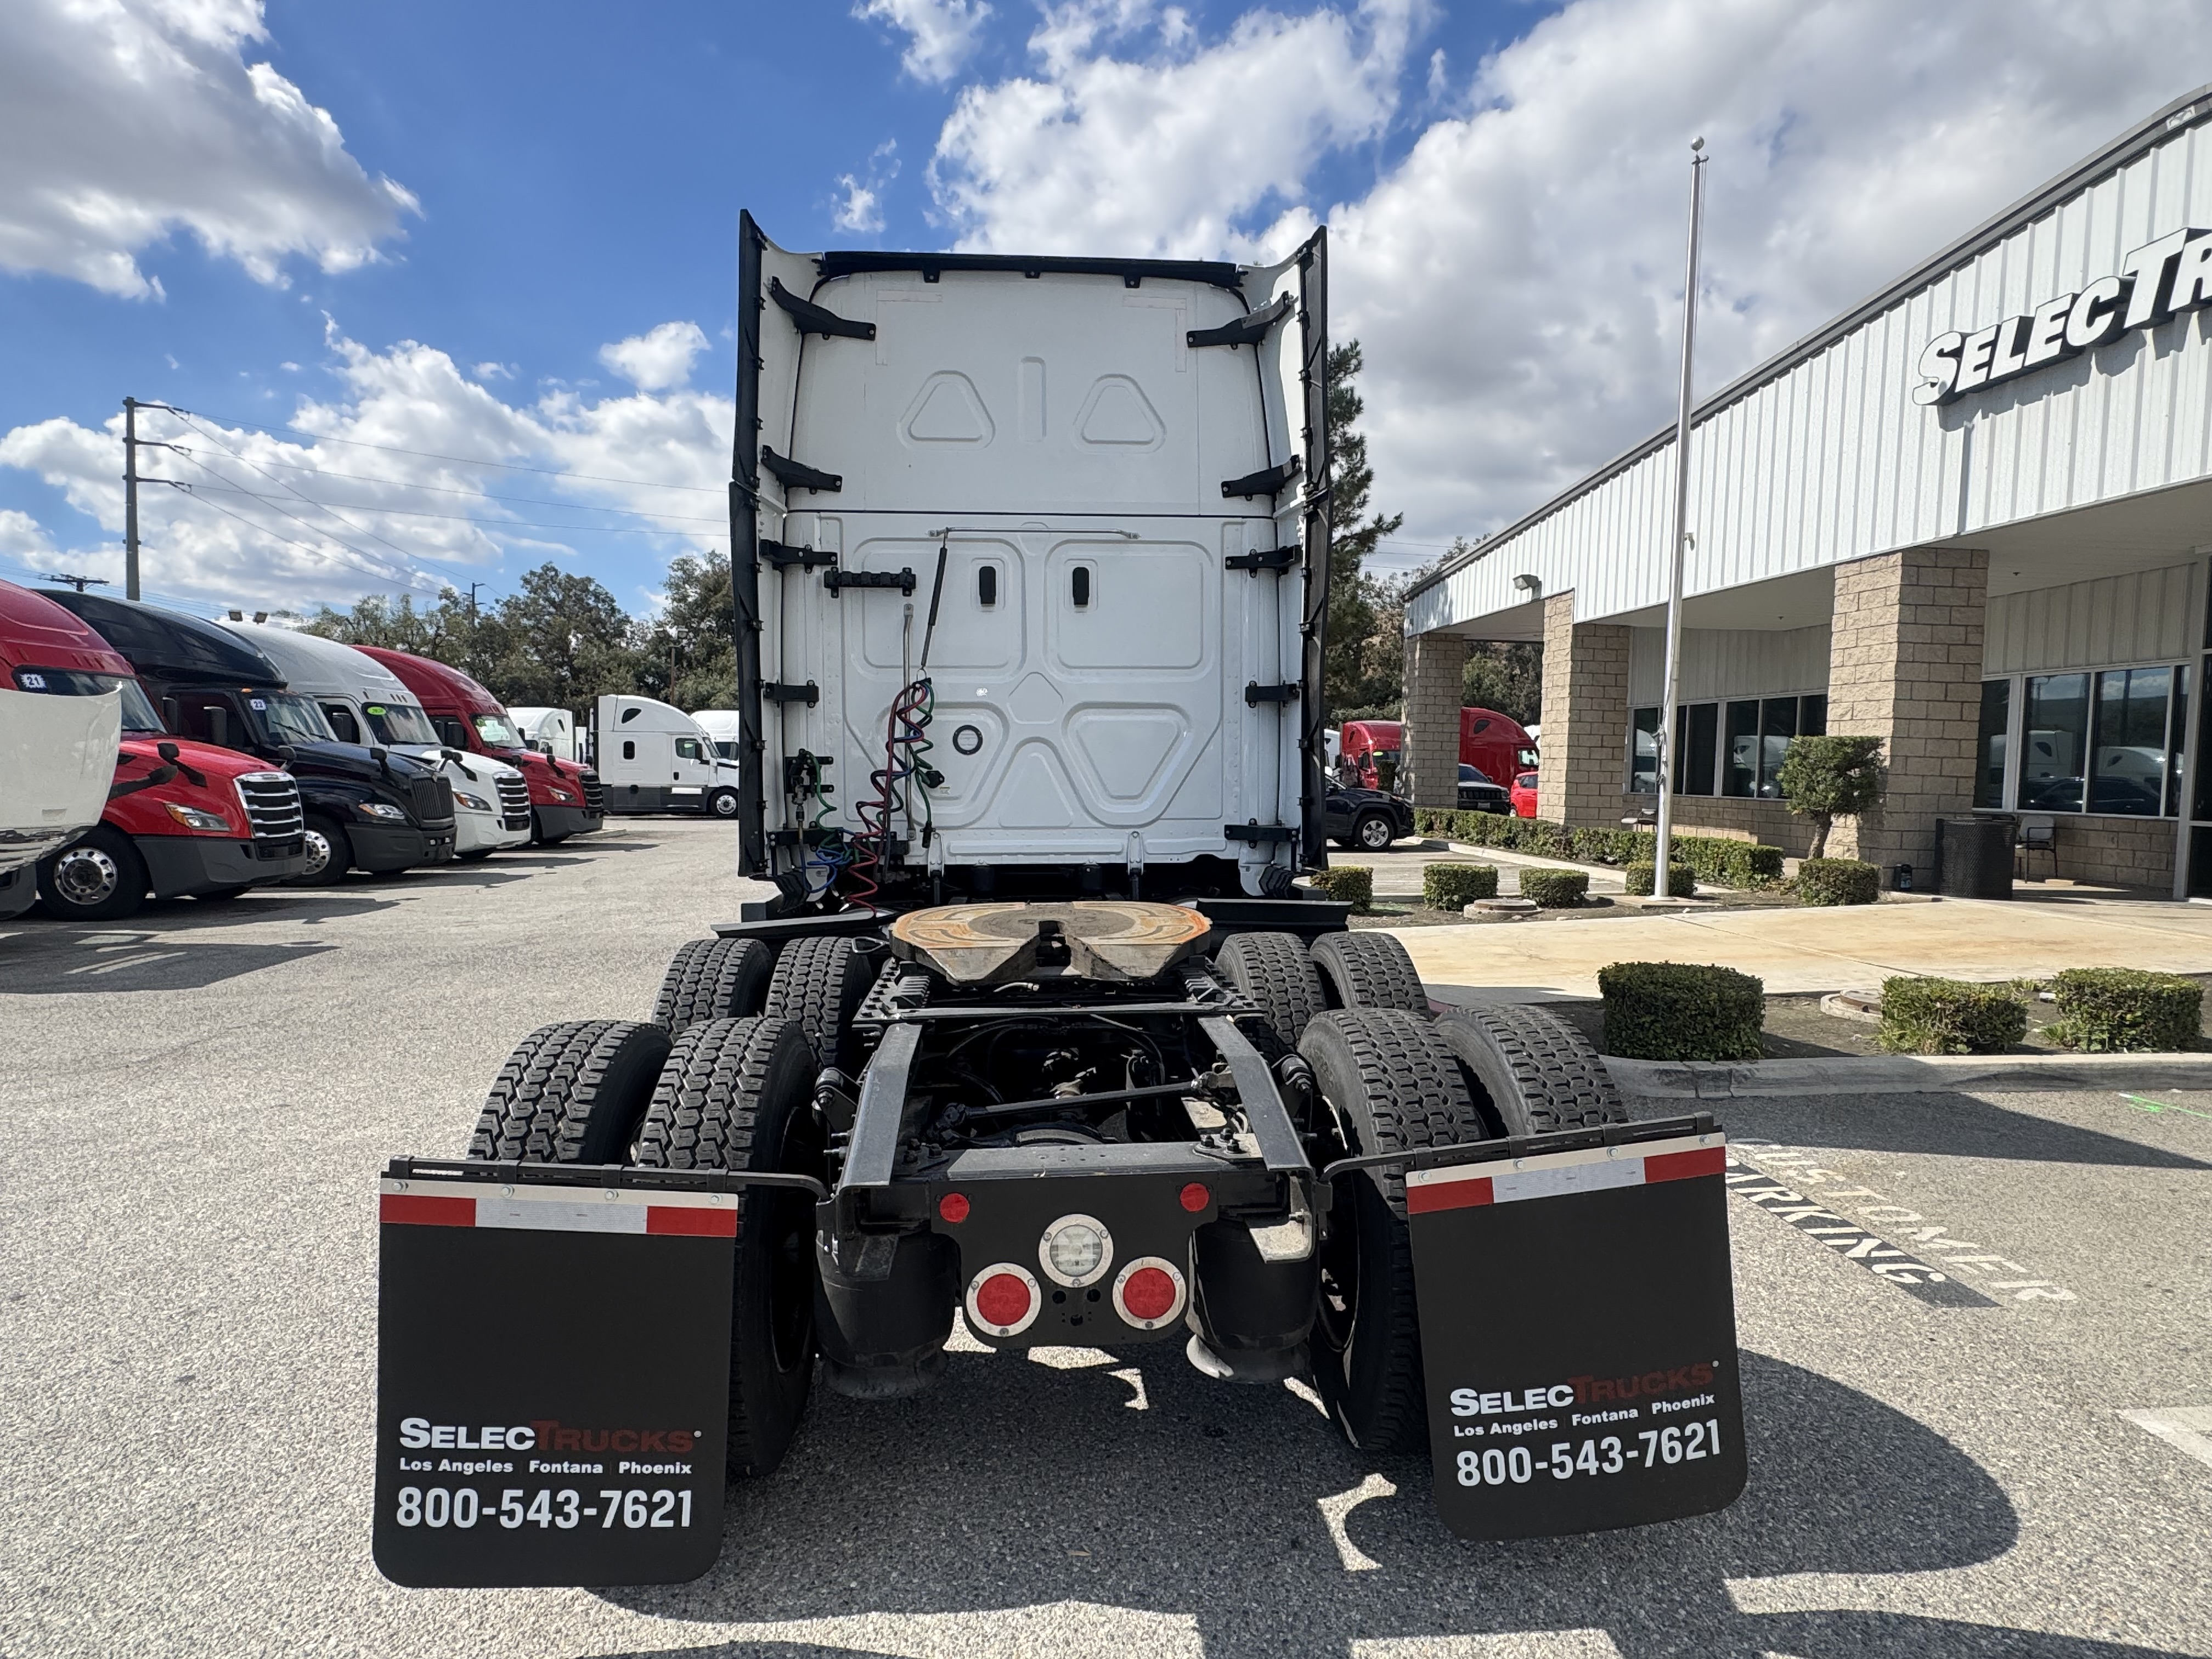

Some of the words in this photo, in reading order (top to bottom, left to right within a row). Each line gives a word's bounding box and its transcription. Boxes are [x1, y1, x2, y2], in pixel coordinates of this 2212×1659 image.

[26, 676, 41, 686] 21
[1726, 1158, 1946, 1284] ARKING
[1454, 1425, 1485, 1437] Los
[1489, 1419, 1558, 1435] Angeles
[1571, 1409, 1639, 1426] Fontana
[1651, 1393, 1715, 1414] Phoenix
[400, 1457, 432, 1471] Los
[438, 1459, 514, 1475] Angeles
[529, 1460, 603, 1474] Fontana
[619, 1462, 692, 1475] Phoenix
[1457, 1419, 1720, 1487] 800-543-7621
[396, 1487, 692, 1528] 800-543-7621
